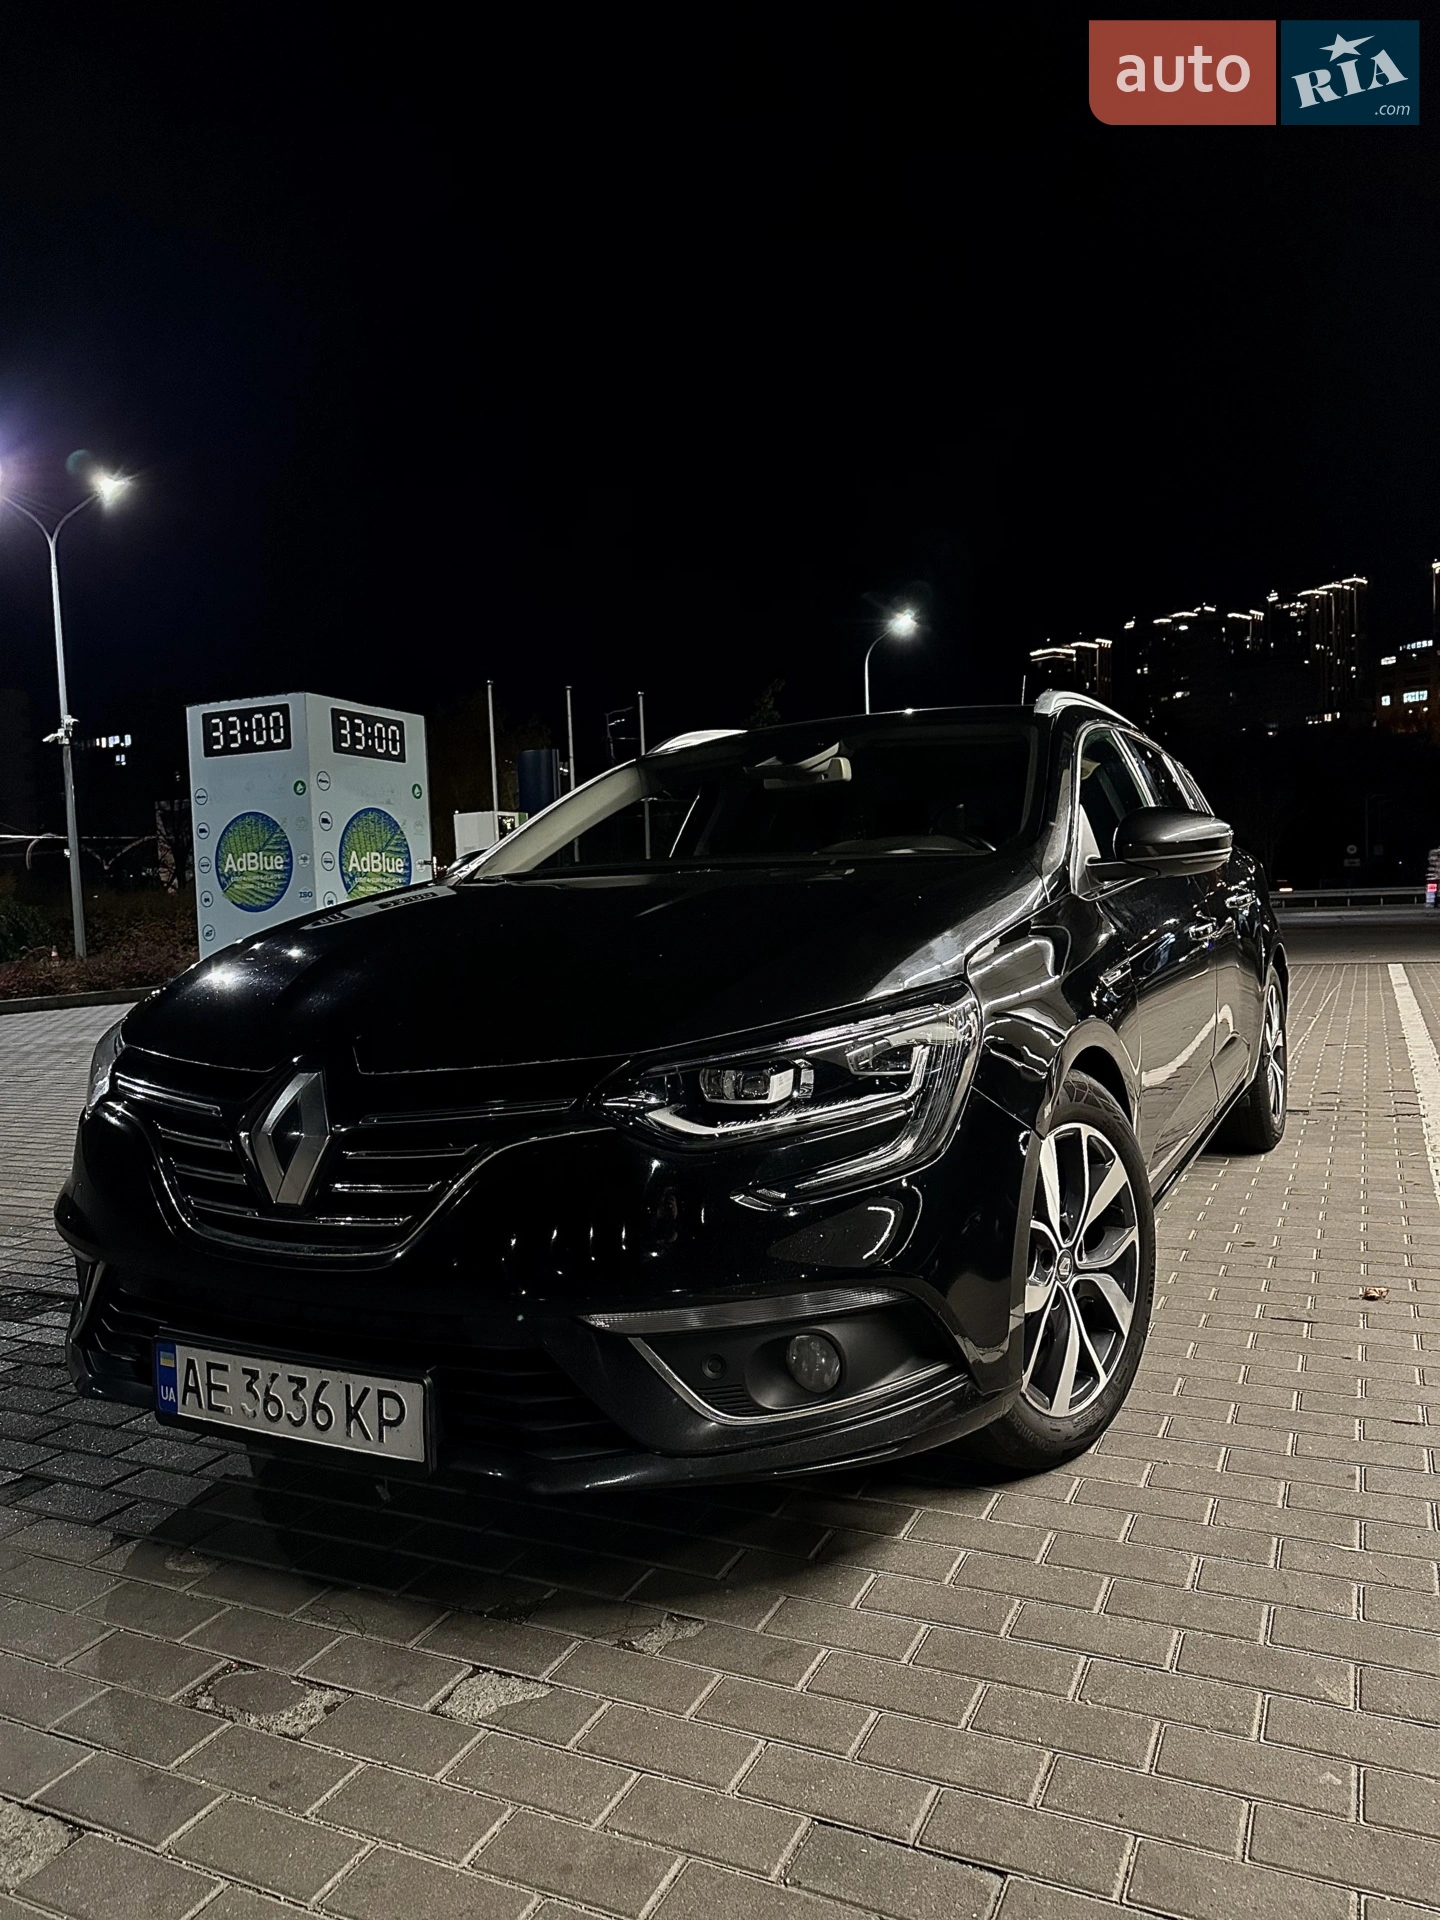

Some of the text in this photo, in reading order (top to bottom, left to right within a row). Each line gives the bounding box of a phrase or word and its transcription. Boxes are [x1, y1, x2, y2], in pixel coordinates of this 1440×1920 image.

[211, 711, 285, 749] 33:00
[339, 716, 400, 755] 33:00
[224, 851, 285, 873] AdBlue
[348, 850, 405, 873] AdBlue
[161, 1385, 176, 1403] UA
[181, 1357, 407, 1443] AE 3636 KP
